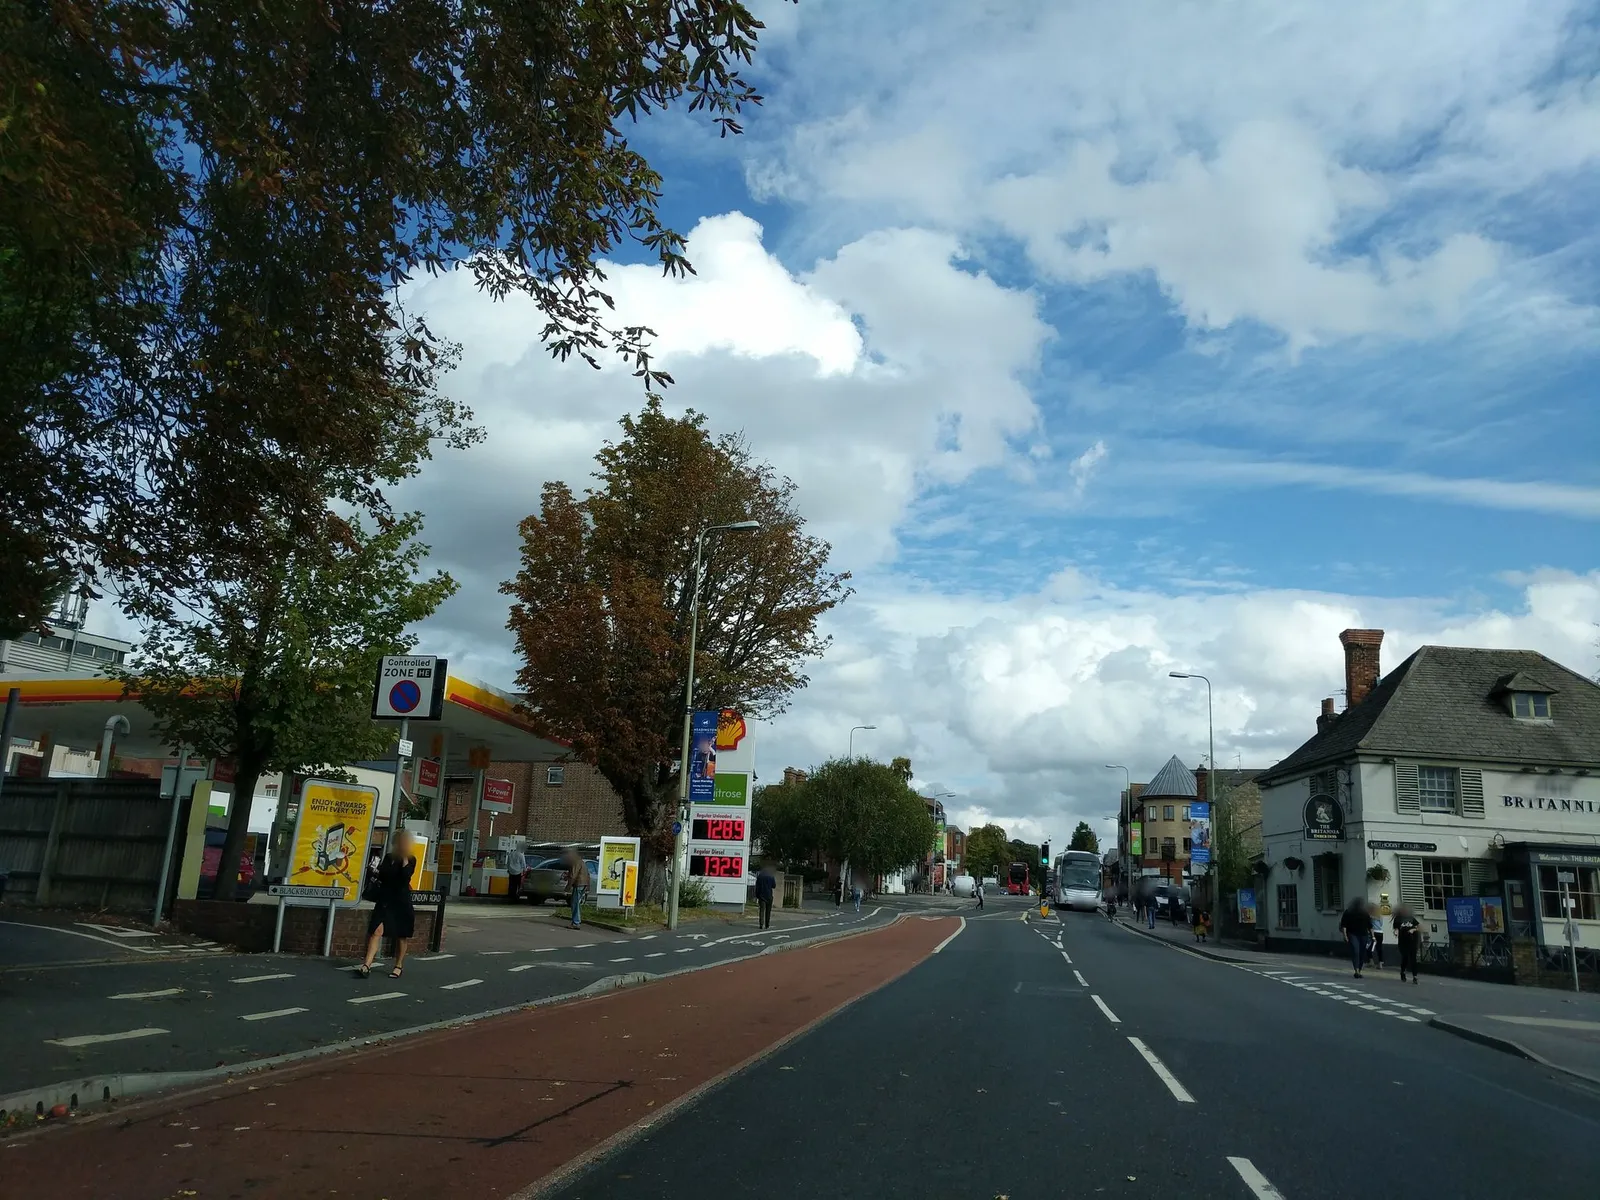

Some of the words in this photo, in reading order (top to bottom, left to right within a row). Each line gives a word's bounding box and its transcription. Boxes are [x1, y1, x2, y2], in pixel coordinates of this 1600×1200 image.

[388, 658, 431, 667] Controlled
[384, 668, 414, 677] ZONE
[418, 669, 431, 677] HE
[487, 786, 509, 796] V-Power
[335, 801, 367, 810] REWARDS
[351, 808, 367, 816] VISIT
[280, 886, 320, 896] BLACKBURN
[320, 888, 342, 897] CLOSE
[411, 893, 428, 902] ONDON
[429, 894, 441, 902] ROAD
